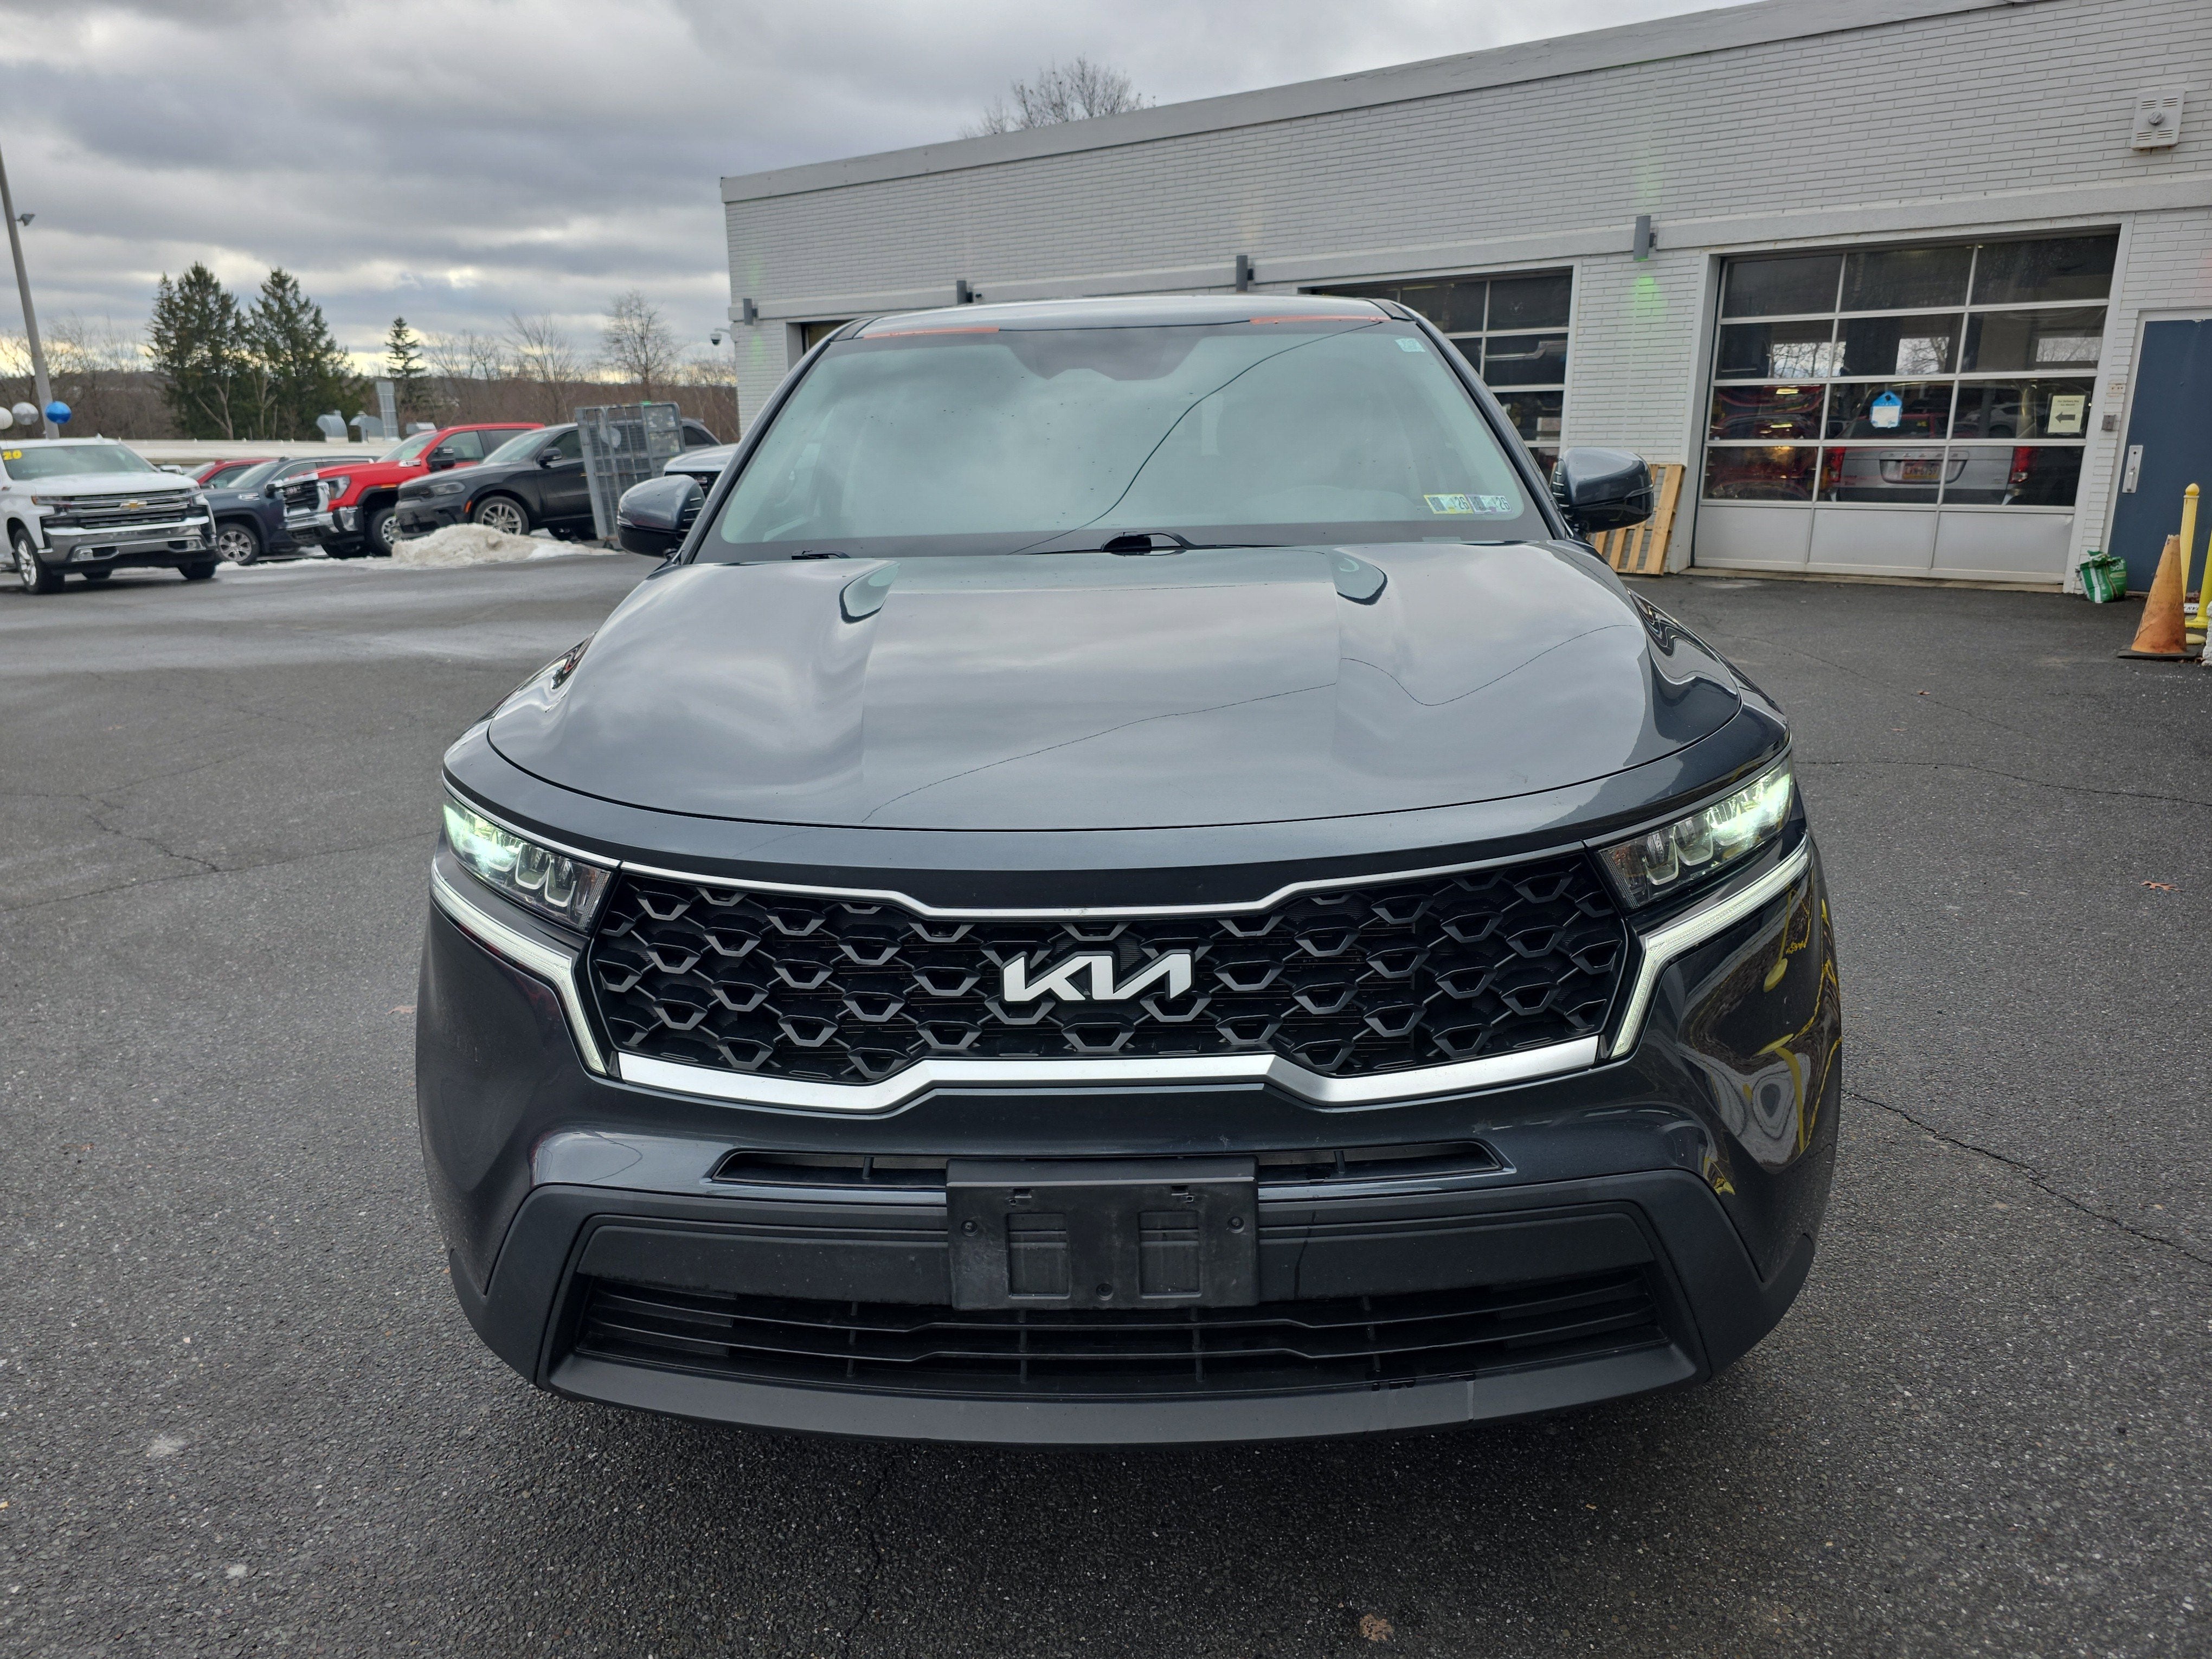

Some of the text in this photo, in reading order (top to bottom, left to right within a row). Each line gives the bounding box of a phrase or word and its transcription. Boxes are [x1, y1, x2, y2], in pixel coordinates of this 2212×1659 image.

[1455, 497, 1470, 510] 26
[1495, 497, 1510, 510] 26
[1004, 953, 1192, 1002] KIA
